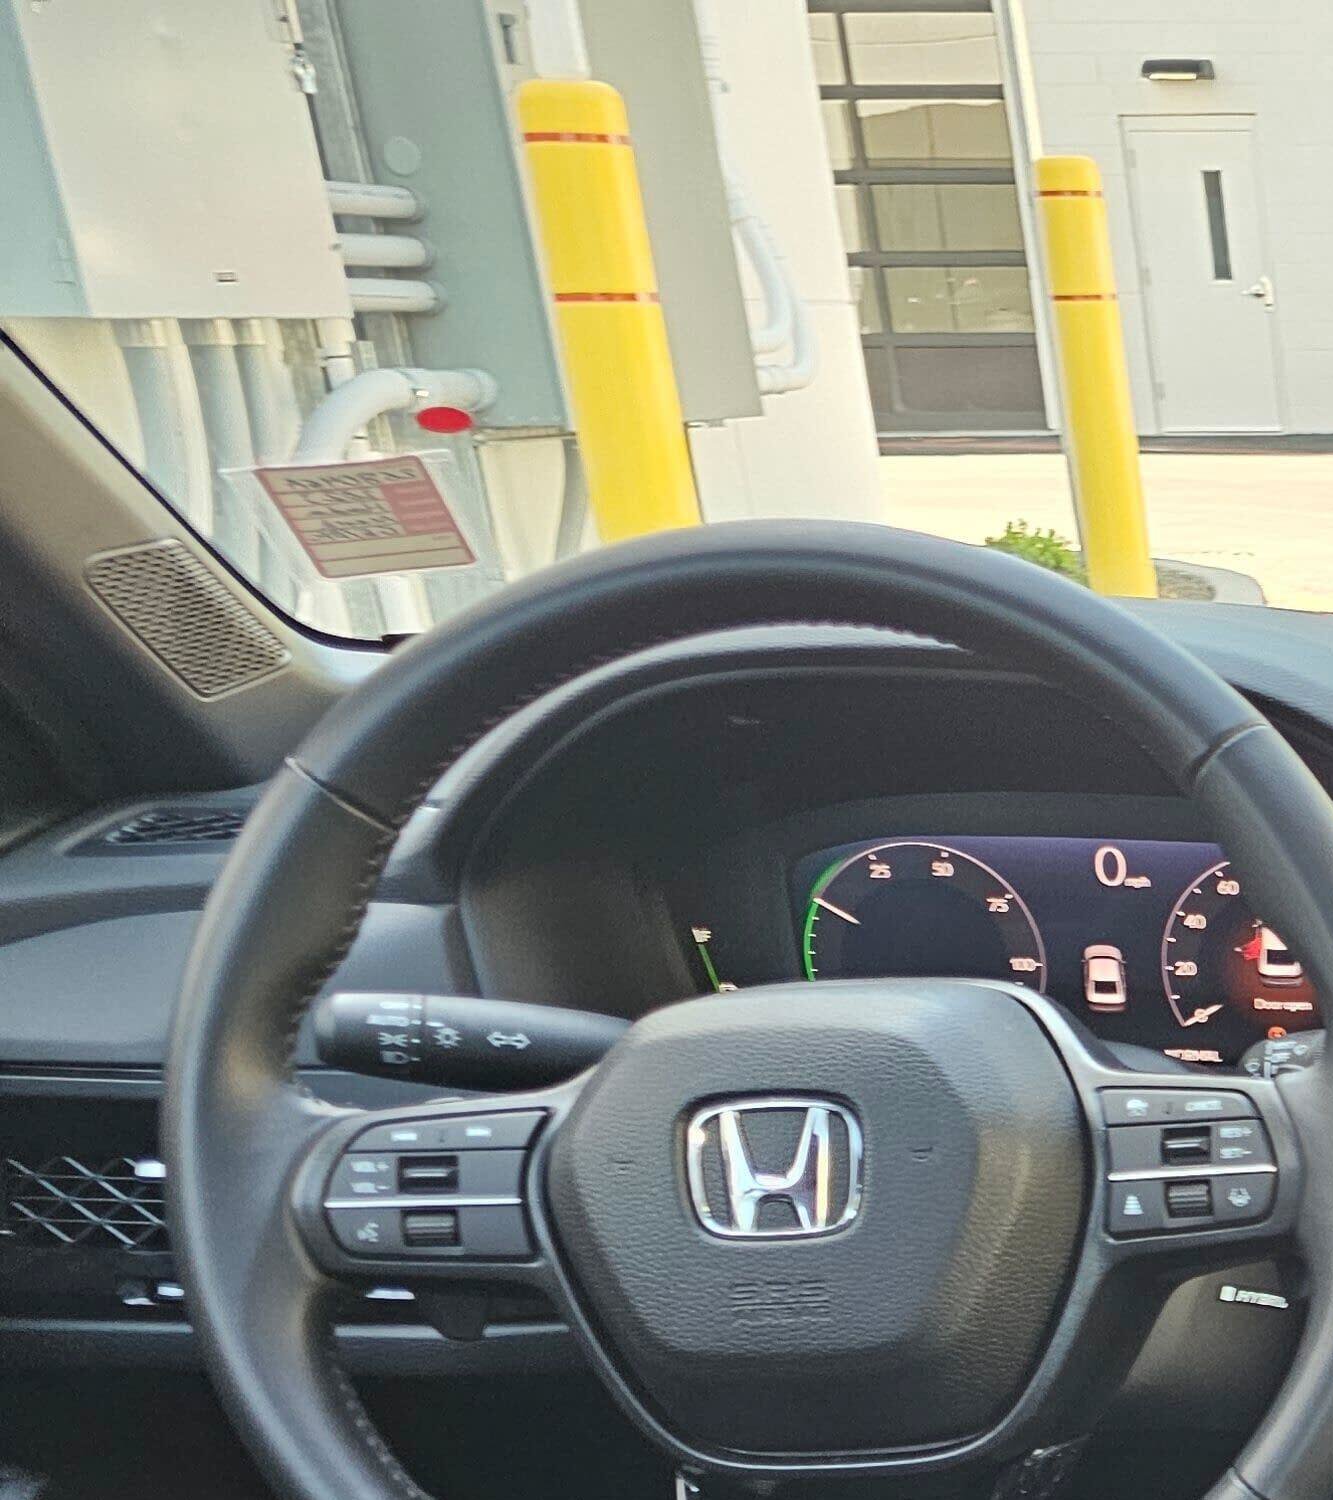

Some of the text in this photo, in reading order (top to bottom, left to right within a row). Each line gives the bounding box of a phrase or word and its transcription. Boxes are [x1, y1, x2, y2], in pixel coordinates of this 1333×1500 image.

[869, 863, 892, 879] 25
[931, 861, 955, 878] 50
[1094, 846, 1128, 887] 0
[1216, 880, 1240, 896] 60
[986, 897, 1010, 912] 75
[1183, 914, 1207, 930] 40
[1174, 961, 1198, 976] 20
